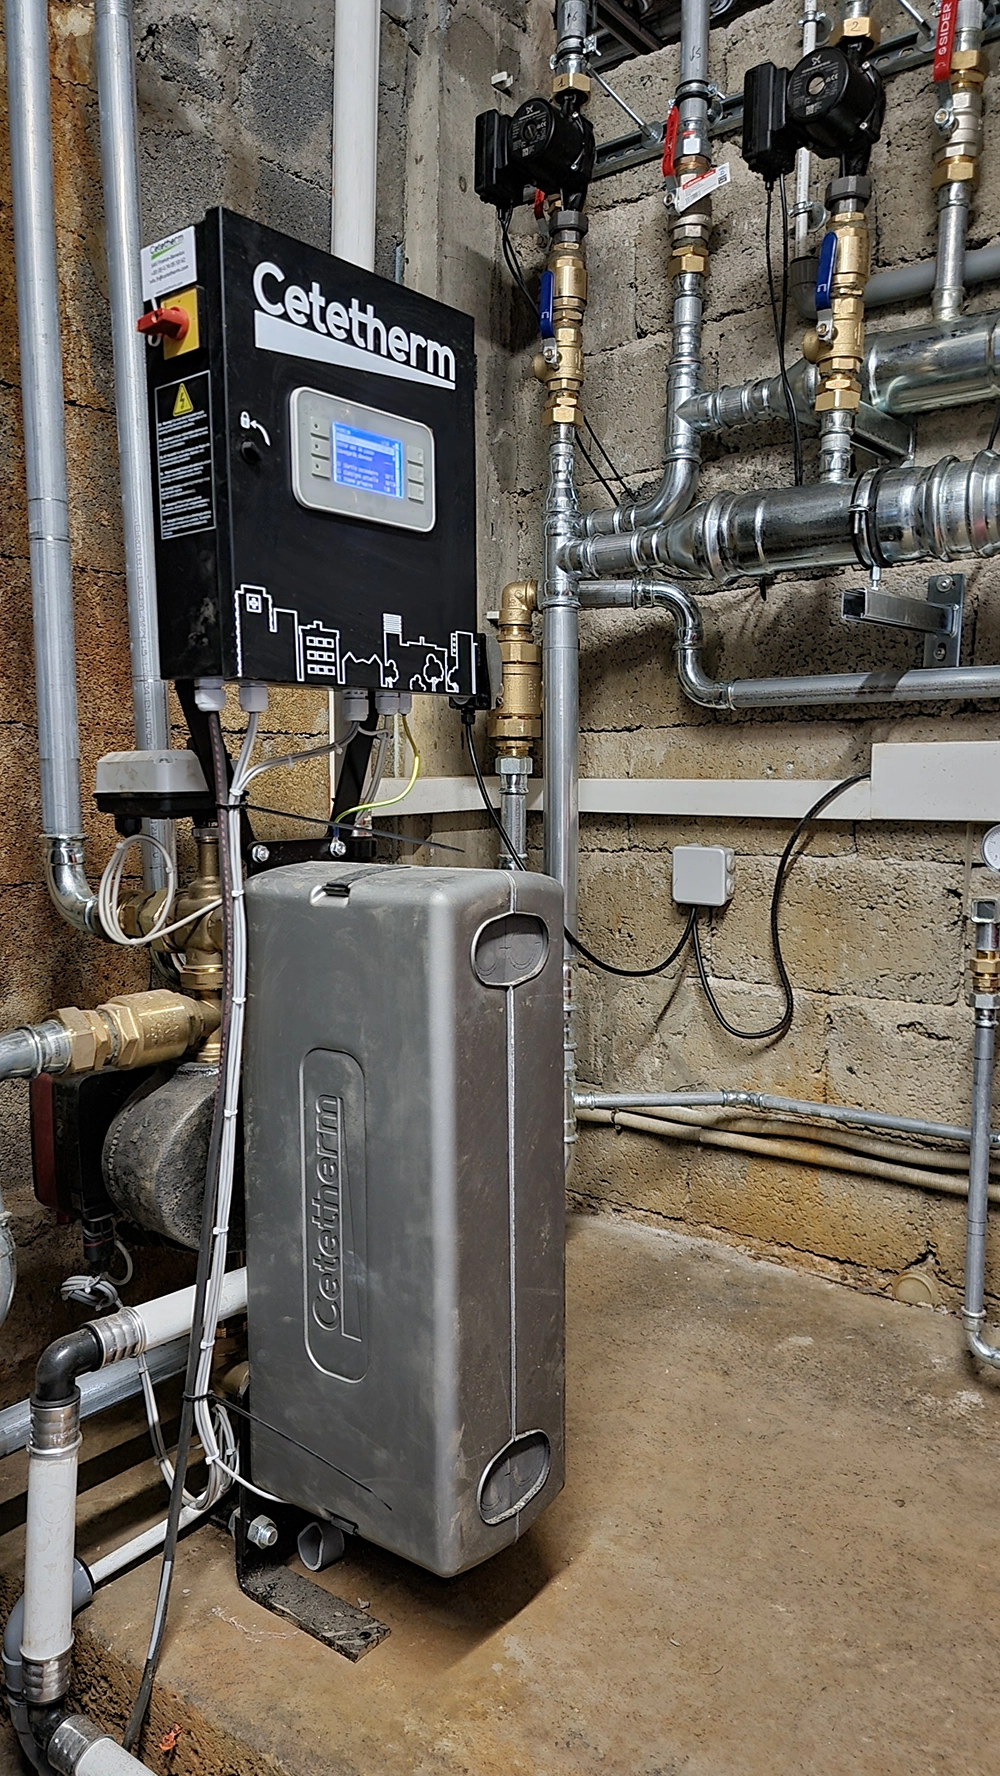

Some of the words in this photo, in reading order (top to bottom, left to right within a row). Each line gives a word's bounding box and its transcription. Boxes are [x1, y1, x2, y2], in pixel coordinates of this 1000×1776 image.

[850, 20, 861, 32] 2
[938, 2, 953, 46] SIDER
[252, 261, 456, 382] Cetetherm
[312, 1093, 340, 1332] Cetetherm
